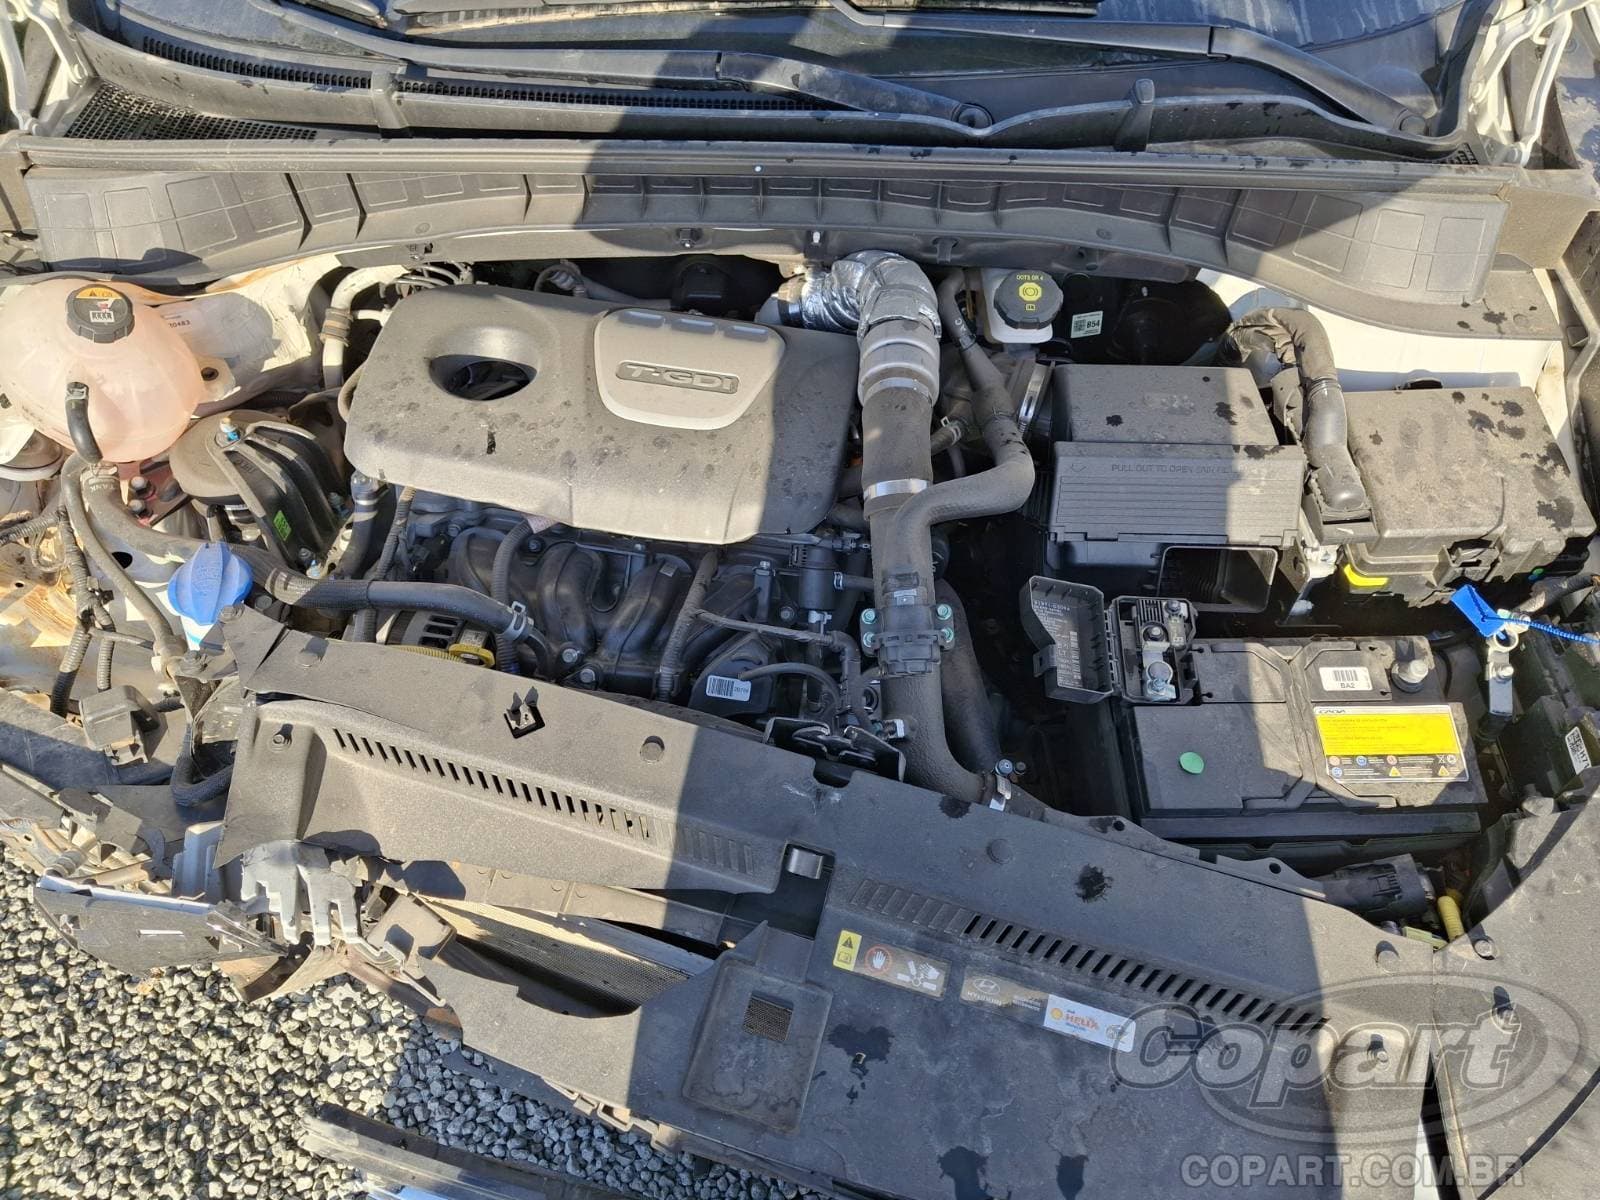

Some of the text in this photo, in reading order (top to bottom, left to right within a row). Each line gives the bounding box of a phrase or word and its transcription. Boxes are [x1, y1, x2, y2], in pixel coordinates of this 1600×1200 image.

[625, 363, 733, 391] T-GDI
[1111, 464, 1133, 472] PULL
[1136, 464, 1153, 473] OUT
